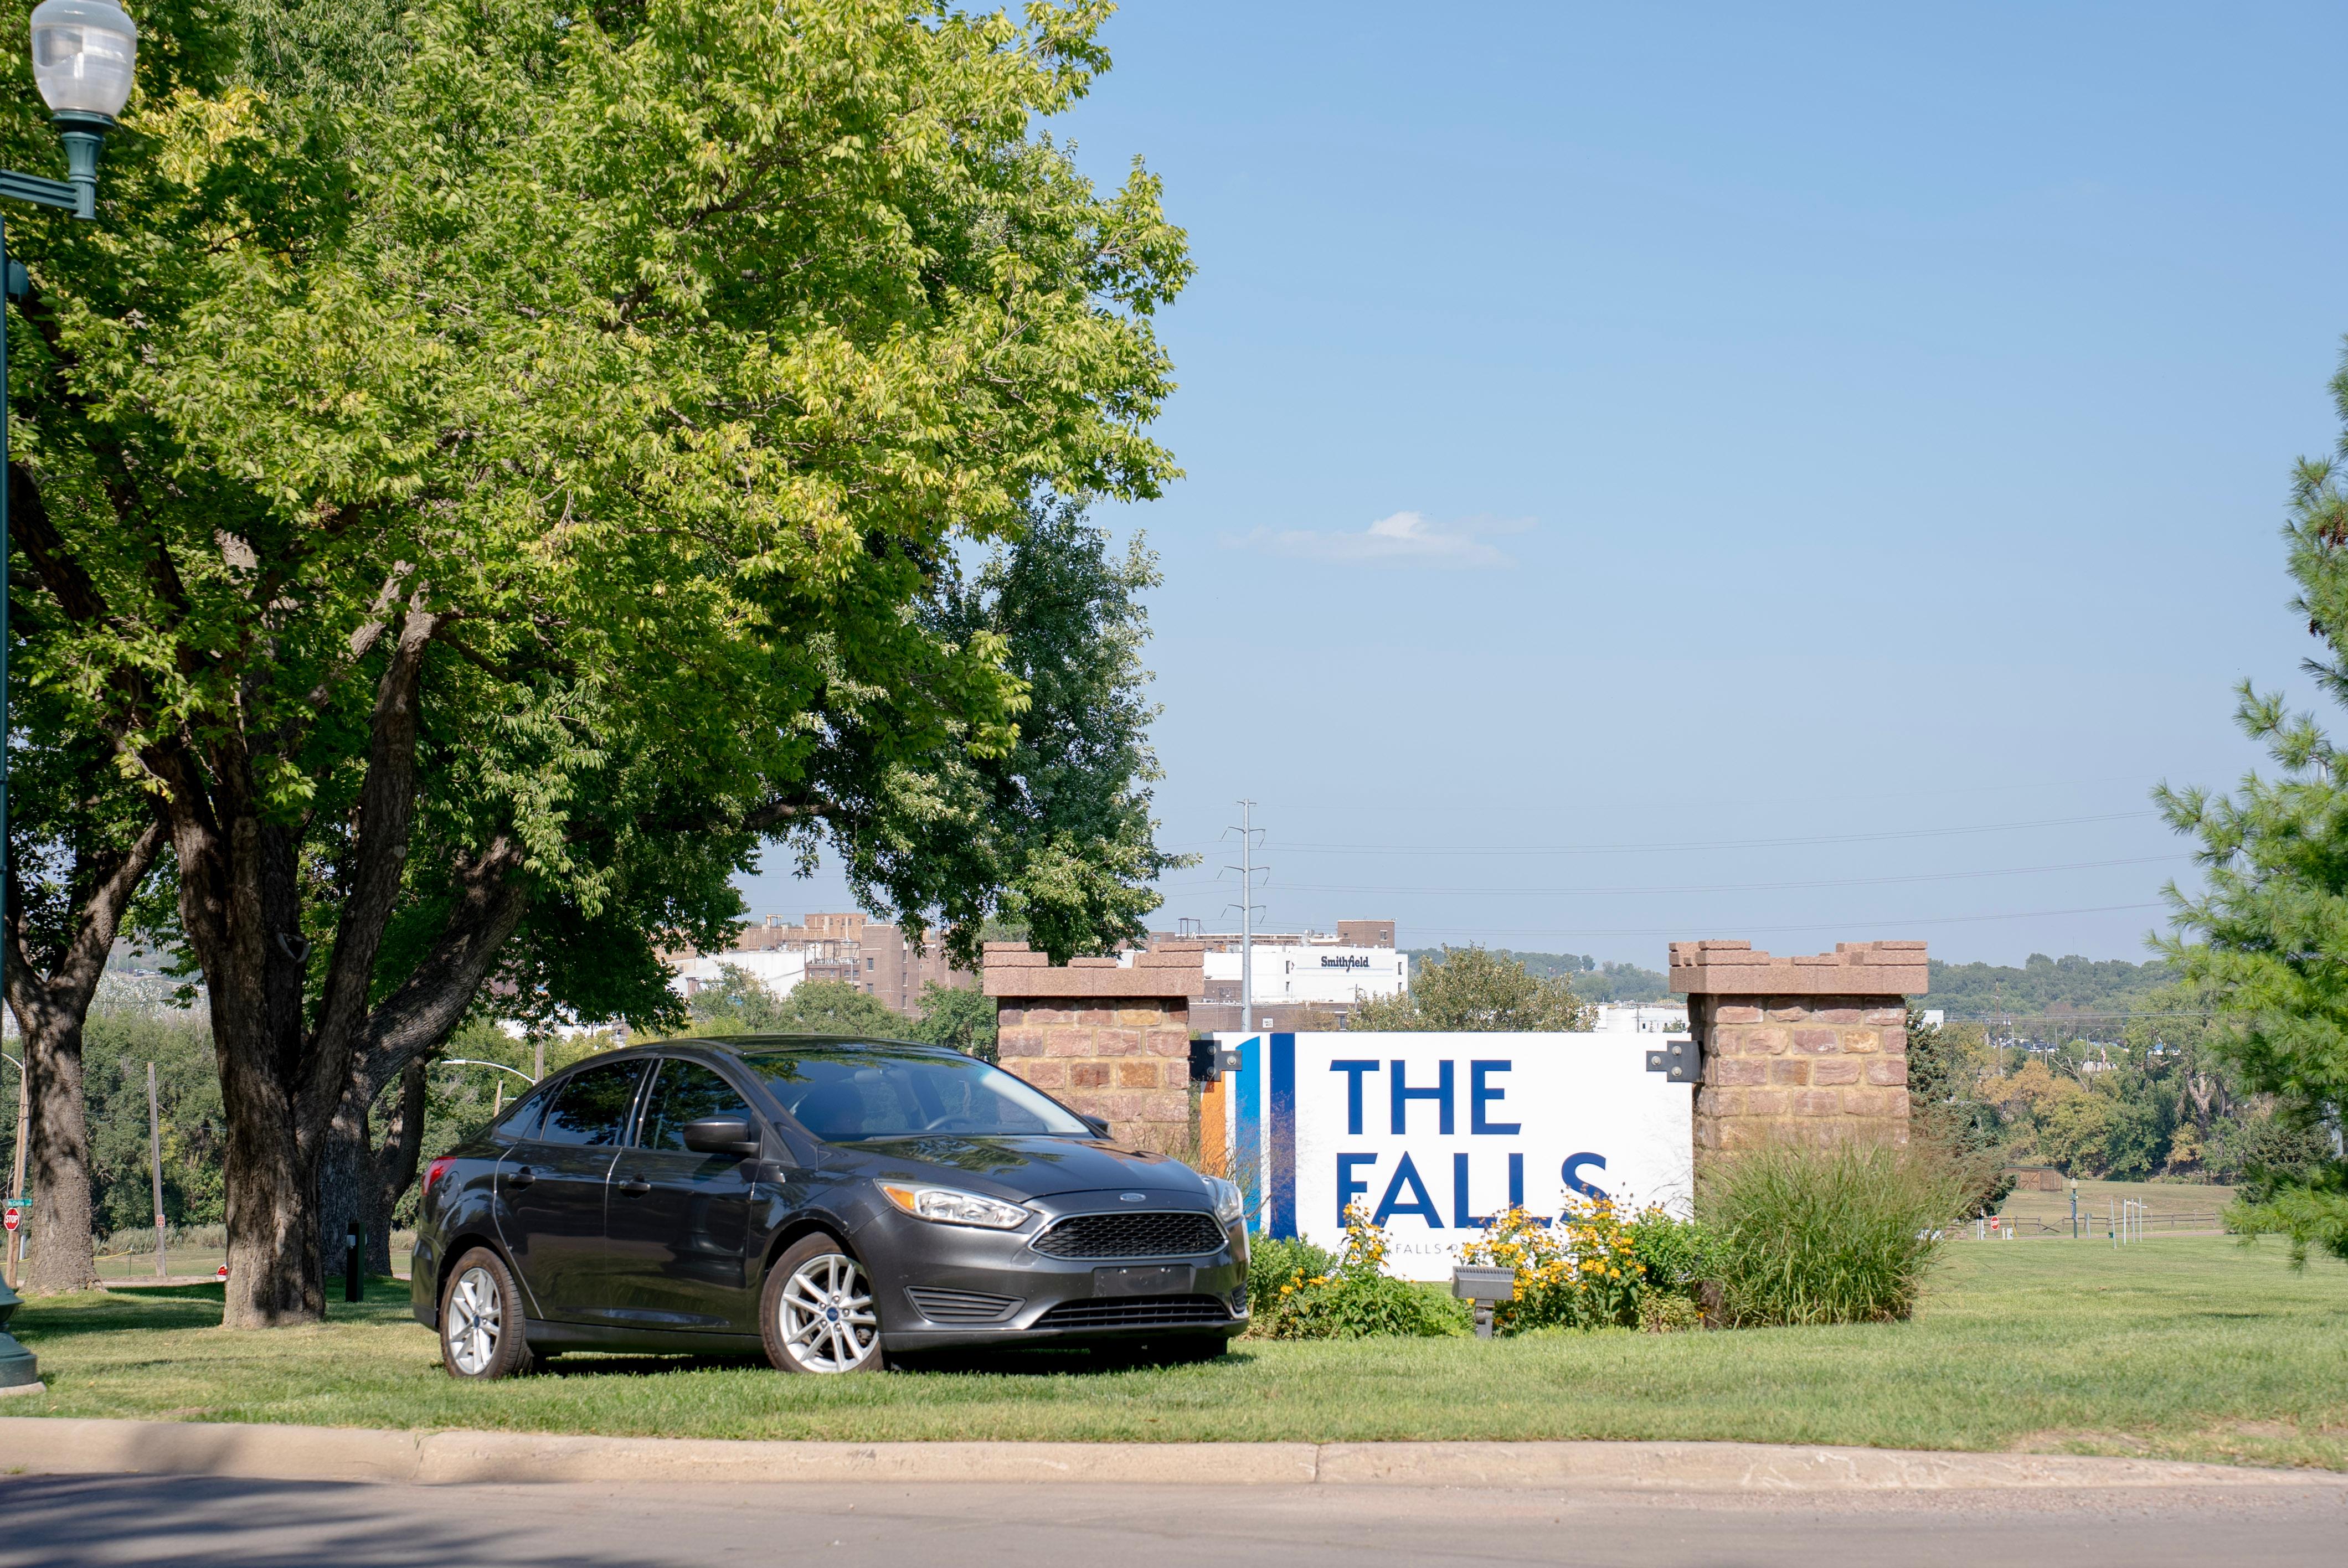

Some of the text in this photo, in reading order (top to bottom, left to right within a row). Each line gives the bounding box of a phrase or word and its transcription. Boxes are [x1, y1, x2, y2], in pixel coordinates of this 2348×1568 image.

[1321, 955, 1369, 973] Smithfield
[1329, 1060, 1522, 1135] THE
[1337, 1151, 1611, 1229] FALLS
[6, 1215, 18, 1224] STOP
[1396, 1244, 1441, 1254] FALLS
